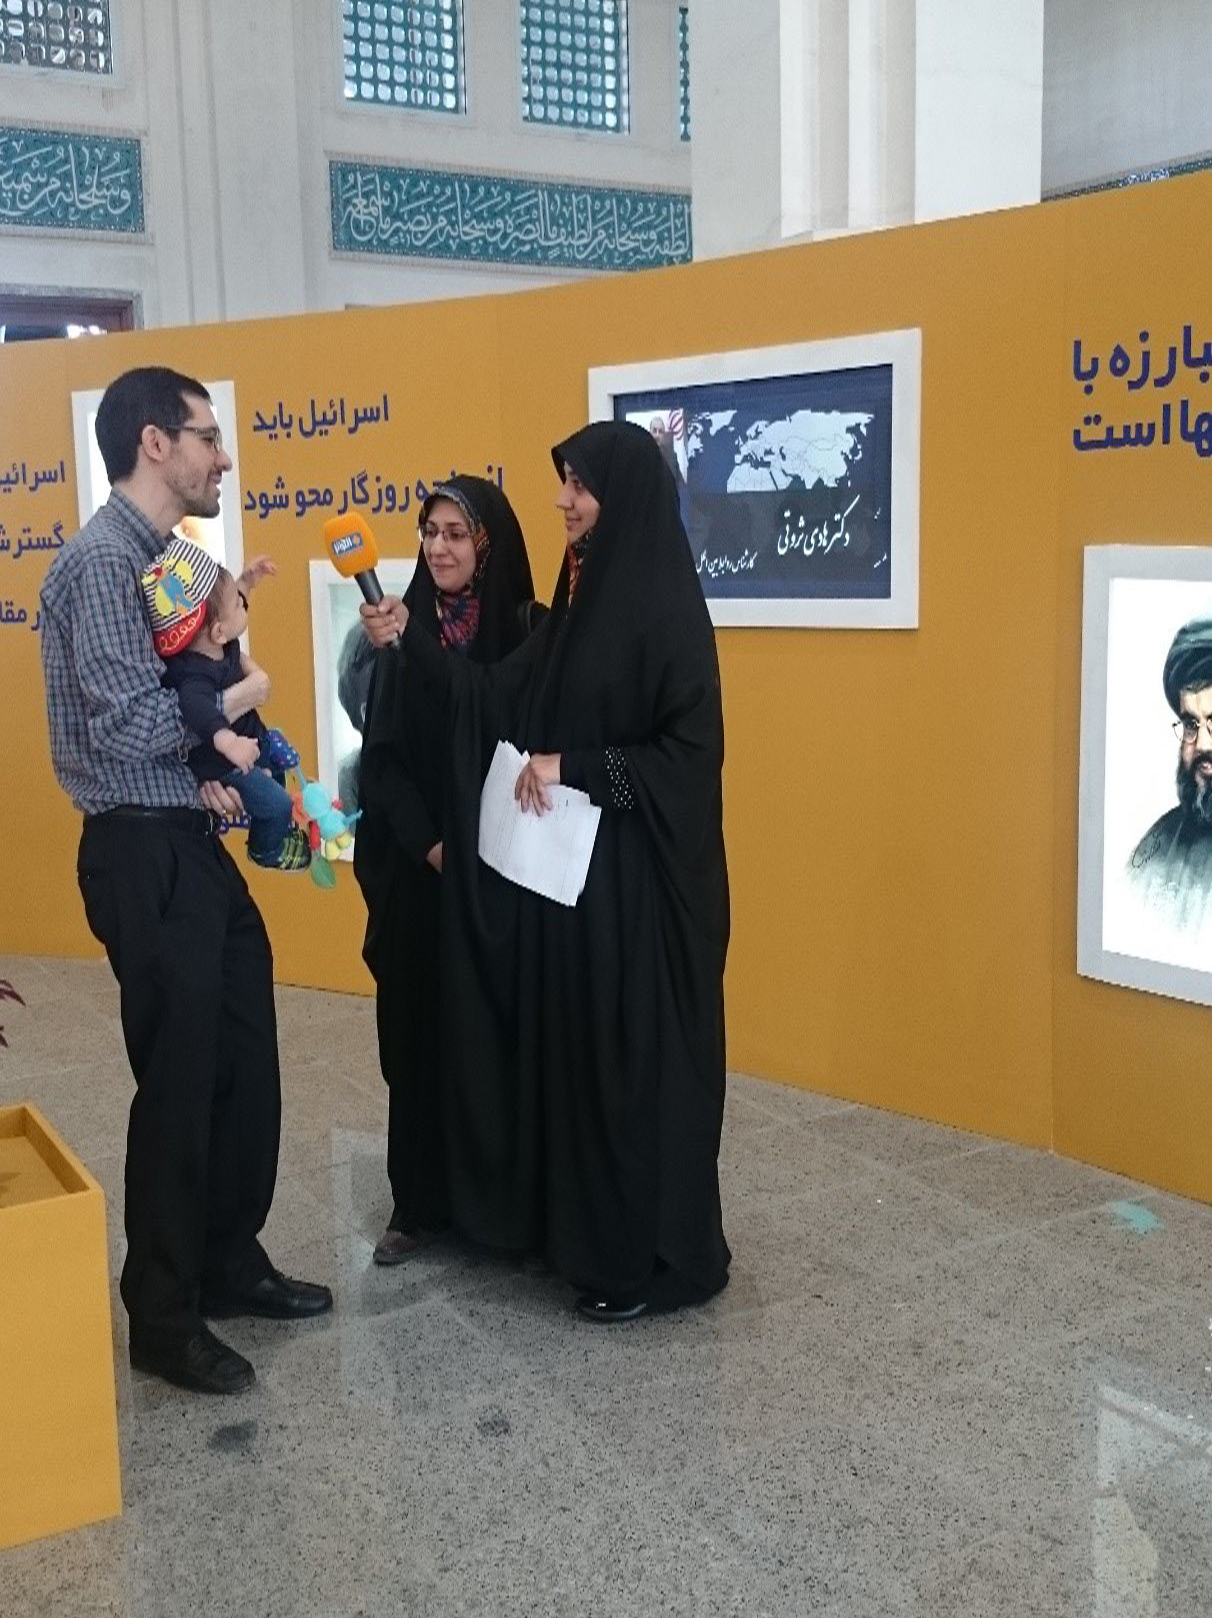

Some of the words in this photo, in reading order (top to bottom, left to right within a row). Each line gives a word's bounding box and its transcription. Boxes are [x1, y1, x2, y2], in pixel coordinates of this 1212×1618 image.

[1073, 339, 1099, 395] با
[1109, 324, 1212, 391] بارزه
[252, 401, 294, 441] باید
[298, 393, 389, 438] اسرائیل
[1073, 402, 1171, 451] است
[0, 460, 66, 493] اسرائی
[243, 475, 290, 520] شود
[336, 468, 411, 515] روزگار
[294, 484, 334, 518] محو
